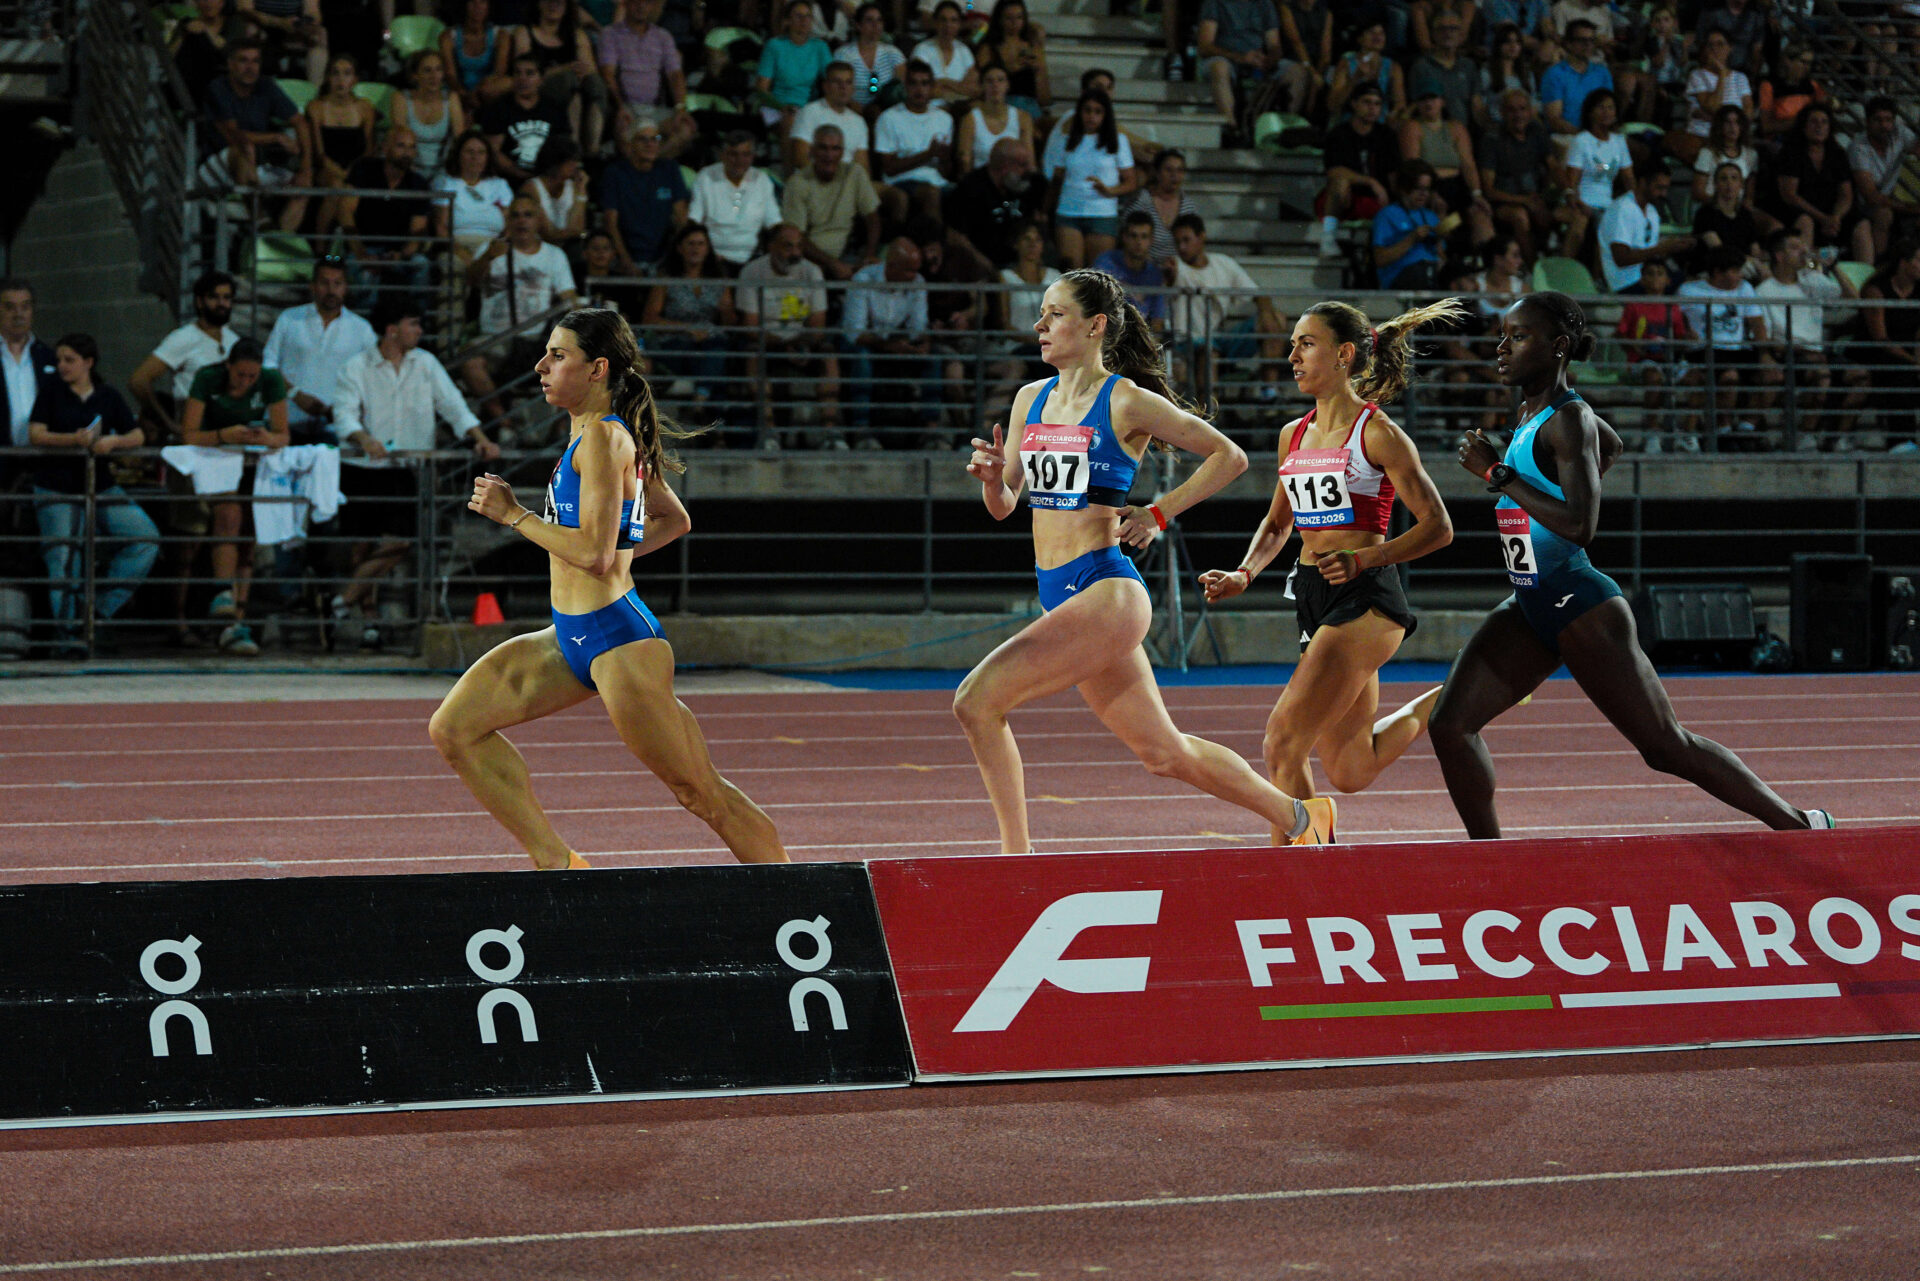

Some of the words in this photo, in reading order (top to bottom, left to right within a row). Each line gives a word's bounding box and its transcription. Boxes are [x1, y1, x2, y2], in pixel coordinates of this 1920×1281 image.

[1035, 434, 1087, 443] FRECCIAROSSA
[1027, 454, 1080, 490] 107
[1288, 475, 1343, 510] 113
[1056, 497, 1078, 507] 2026
[1322, 513, 1346, 524] 2026
